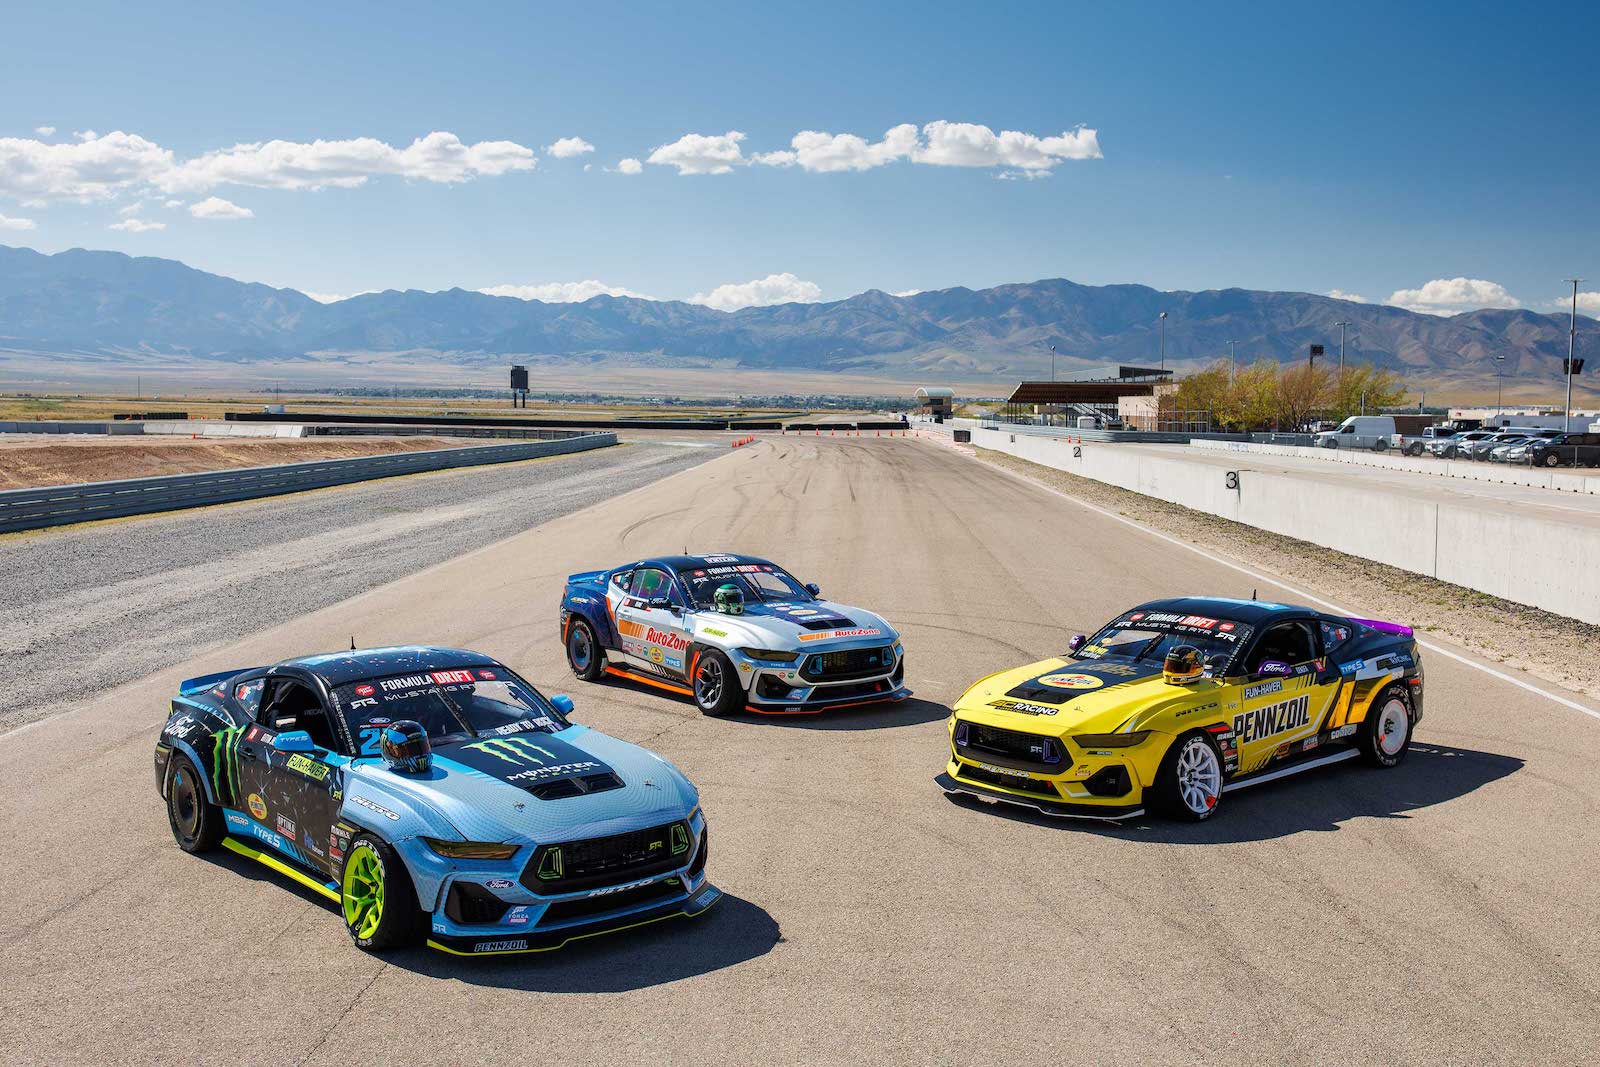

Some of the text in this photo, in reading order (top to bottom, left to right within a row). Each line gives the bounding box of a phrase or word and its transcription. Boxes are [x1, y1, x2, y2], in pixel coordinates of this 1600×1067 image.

[1073, 446, 1081, 457] 2
[1225, 471, 1238, 489] 3
[707, 565, 737, 575] FORMULA
[737, 564, 760, 572] DRIFT
[1145, 613, 1186, 623] FORMULA
[1184, 616, 1217, 628] DRIFT
[834, 628, 880, 638] AutoZone
[1264, 663, 1286, 673] Ford
[380, 674, 435, 692] FORMULA
[433, 670, 473, 685] DRIFT
[1244, 680, 1283, 700] FUN-HAVER
[1014, 702, 1058, 716] RACING
[1175, 702, 1218, 717] NITTO
[1233, 694, 1311, 744] PENNZOIL
[291, 755, 327, 779] FUN-HAVER
[506, 761, 601, 782] MONSTER
[350, 795, 401, 821] NITTO
[253, 824, 281, 849] TYPES
[490, 880, 510, 889] Ford
[587, 878, 655, 897] NITTO
[473, 939, 528, 953] PENNZOIL
